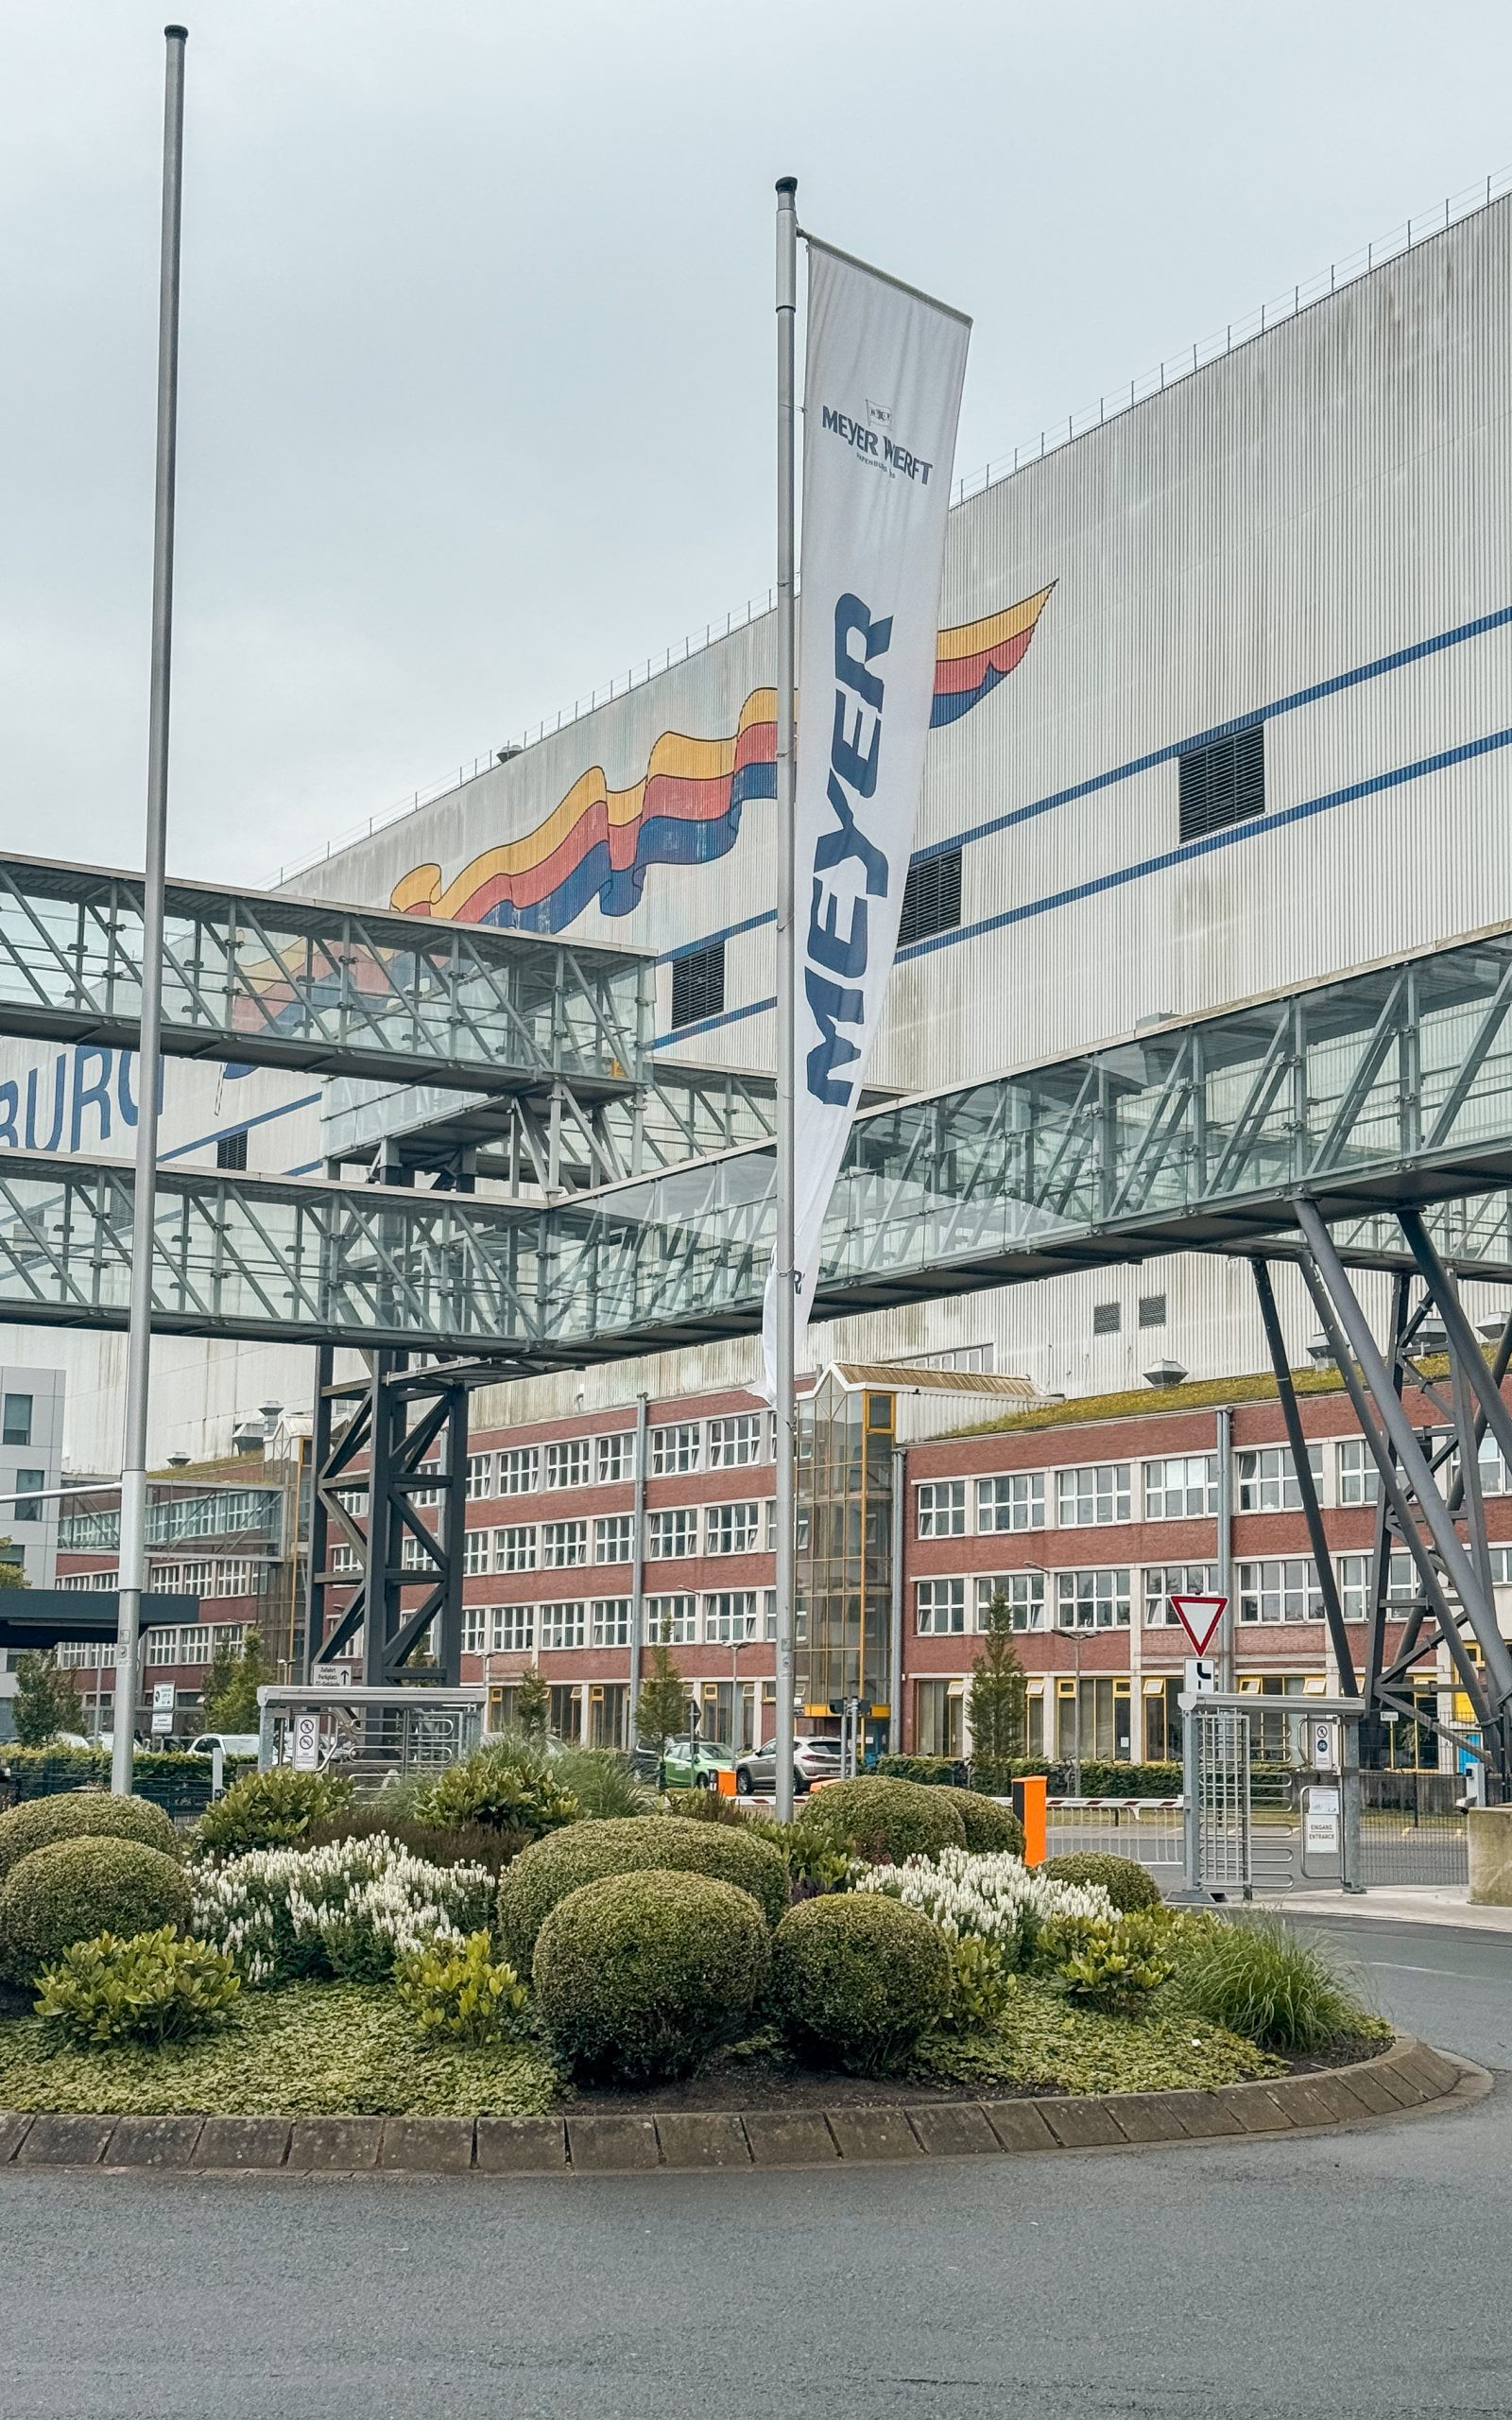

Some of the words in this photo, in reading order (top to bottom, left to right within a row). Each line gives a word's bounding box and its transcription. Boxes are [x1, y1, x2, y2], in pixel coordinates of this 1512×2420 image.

[822, 405, 879, 456] MEYER
[883, 435, 933, 486] WERFT
[805, 593, 894, 1107] MEYER
